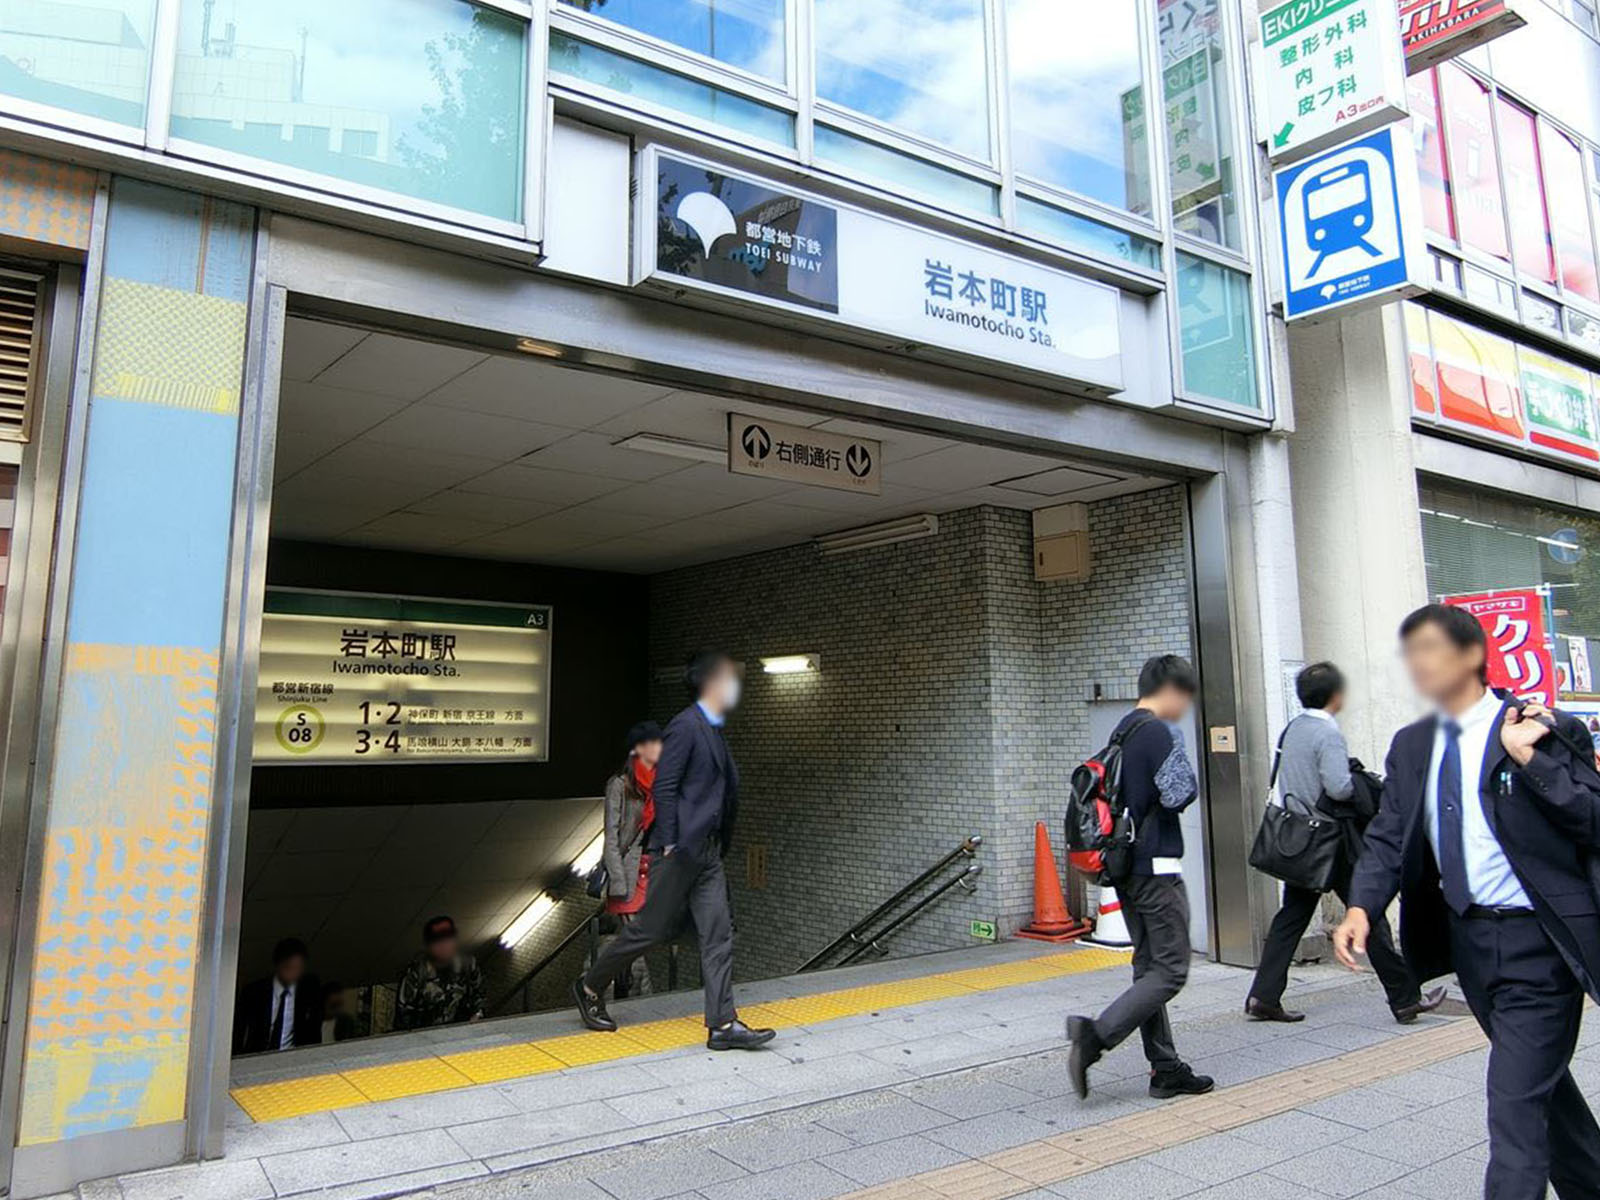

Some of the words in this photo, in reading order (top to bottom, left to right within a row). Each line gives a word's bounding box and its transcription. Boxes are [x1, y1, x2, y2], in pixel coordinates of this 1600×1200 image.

[1280, 9, 1367, 68] 整形外科
[1408, 8, 1479, 44] AKIHABARA
[1298, 74, 1357, 117] 皮フ科
[746, 221, 822, 257] 都営地下鉄
[745, 242, 771, 260] TOEI
[775, 250, 823, 273] SUBWAY
[924, 258, 1048, 325] 岩本町駅
[925, 299, 1025, 340] Iwamotocho
[1029, 326, 1057, 348] Sta.
[776, 441, 841, 471] 右側通行
[527, 614, 544, 625] A3
[340, 629, 456, 661] 岩本町駅
[333, 660, 429, 676] Iwamotocho
[434, 664, 461, 678] Sta.
[272, 682, 334, 695] 都営新宿線
[288, 728, 312, 742] 08
[296, 713, 306, 726] S
